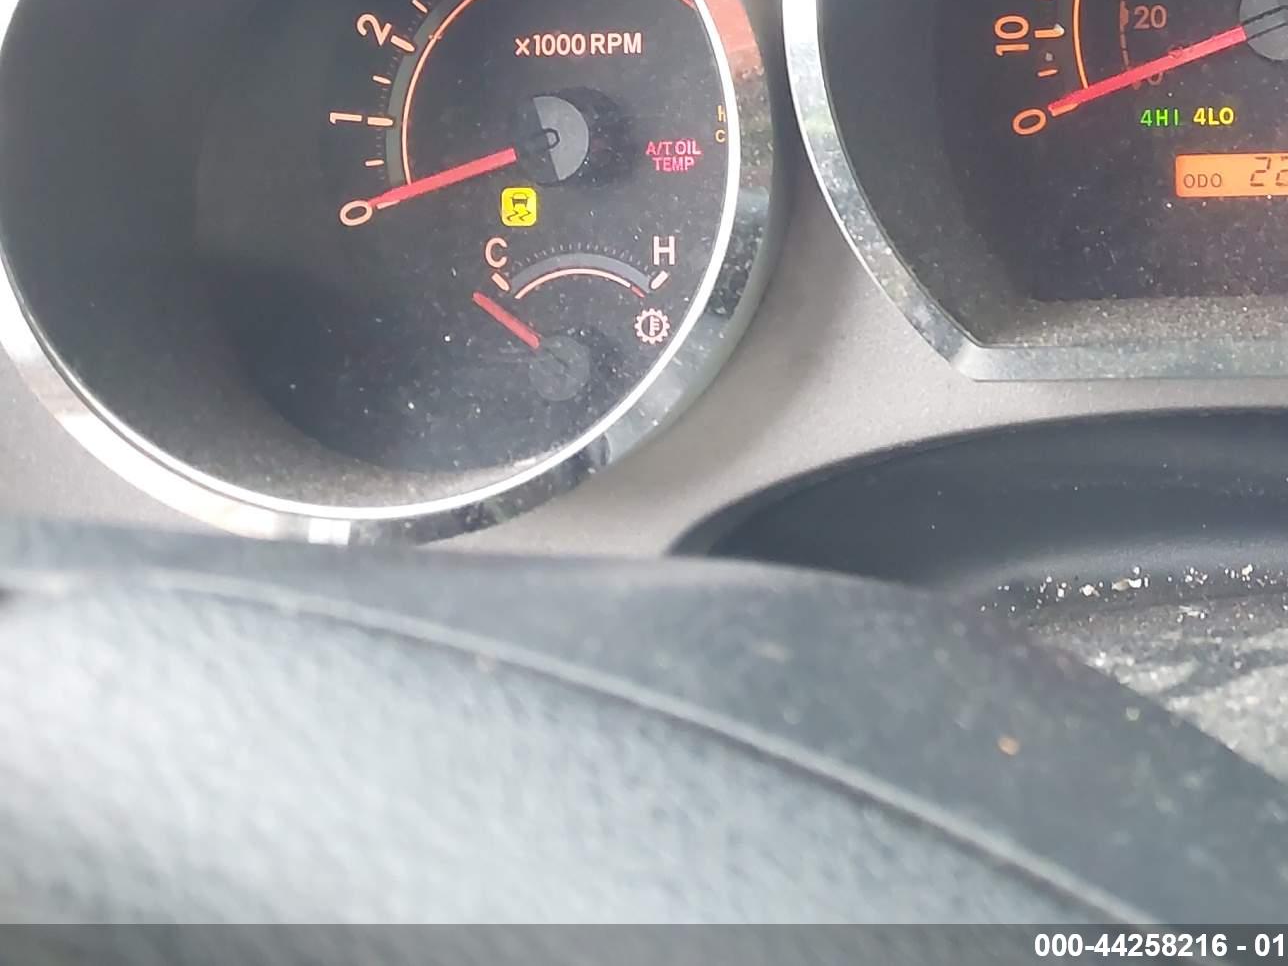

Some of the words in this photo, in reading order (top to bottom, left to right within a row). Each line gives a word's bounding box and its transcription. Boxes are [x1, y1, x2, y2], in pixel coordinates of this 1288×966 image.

[1133, 5, 1167, 29] 20
[356, 14, 392, 46] 2
[994, 15, 1030, 56] 10
[329, 110, 363, 126] 1
[1012, 108, 1047, 135] 0
[1140, 109, 1180, 127] 4HI
[1192, 107, 1235, 126] 4LO
[675, 139, 702, 155] OIL
[652, 155, 695, 172] TEMP
[1183, 173, 1223, 189] ODO
[339, 199, 374, 227] 0
[484, 237, 508, 268] C
[652, 236, 676, 266] H
